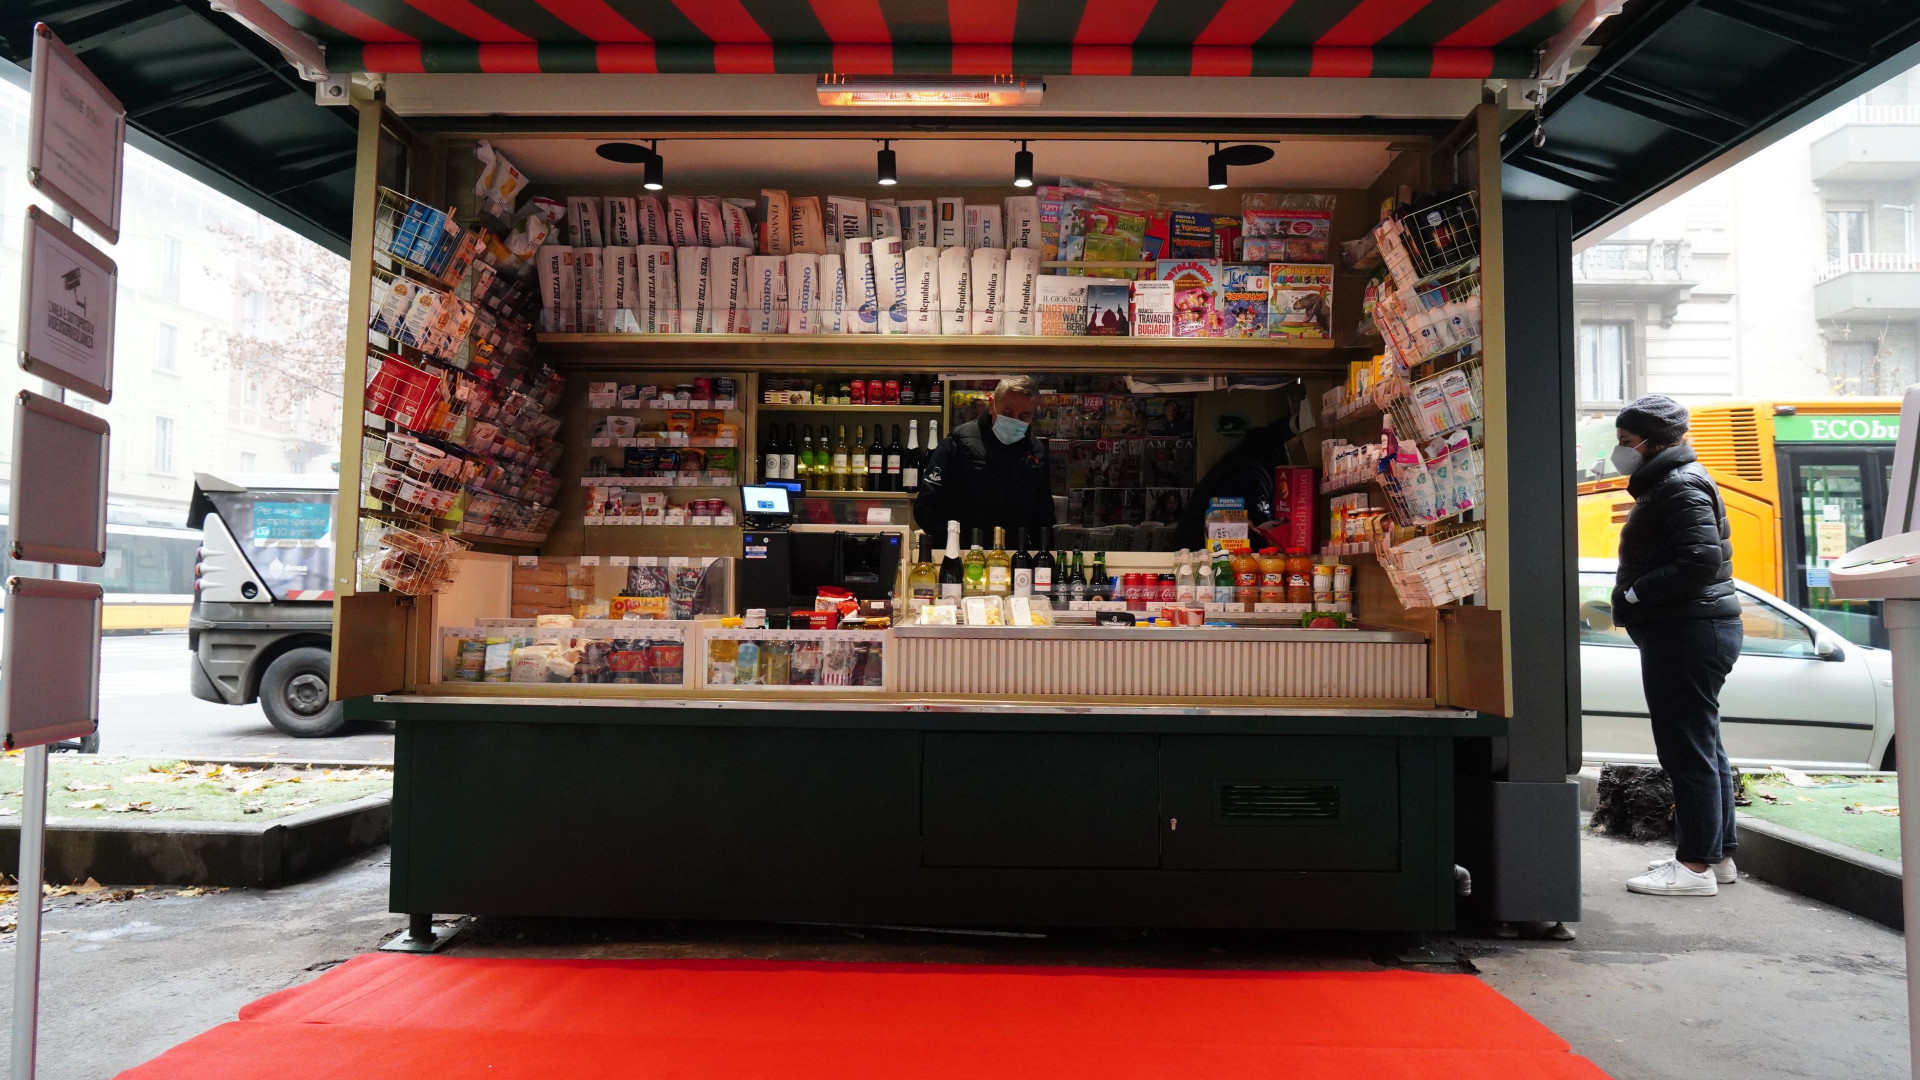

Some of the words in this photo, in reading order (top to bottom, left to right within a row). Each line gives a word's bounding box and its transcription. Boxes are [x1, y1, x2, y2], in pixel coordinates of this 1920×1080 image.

[619, 216, 628, 245] PREA
[843, 215, 858, 240] Rifo
[984, 220, 990, 233] IL
[1020, 228, 1030, 248] Repu
[700, 256, 708, 276] SERA
[1286, 267, 1330, 275] DINOSAURI
[552, 278, 560, 300] DELLA
[648, 276, 656, 299] DELLA
[698, 278, 706, 300] DELLA
[730, 278, 738, 300] DELLA
[1273, 275, 1330, 284] ENIGMISTICA
[763, 269, 771, 314] GIORNO
[801, 267, 811, 313] GIORNO
[834, 268, 843, 314] GIORNO
[860, 262, 878, 320] Avvenire
[890, 261, 907, 319] Avvenire
[920, 272, 930, 313] Repubblica
[956, 272, 967, 314] Repubblica
[986, 273, 998, 314] Repubblica
[1020, 274, 1032, 315] Repubblica
[1226, 292, 1267, 300] TOPOLINO
[762, 318, 770, 331] IL
[800, 317, 807, 330] IL
[834, 317, 840, 331] IL
[919, 314, 928, 322] la
[985, 314, 993, 323] la
[1063, 313, 1087, 322] WALK
[1139, 315, 1170, 324] TRAVAGLIO
[1138, 324, 1170, 334] BUGIARDI
[1810, 420, 1900, 439] ECObu
[257, 506, 272, 514] Per
[256, 527, 269, 536] Da
[257, 518, 288, 526] sempre
[291, 518, 325, 526] speciale
[1296, 524, 1306, 546] Baci
